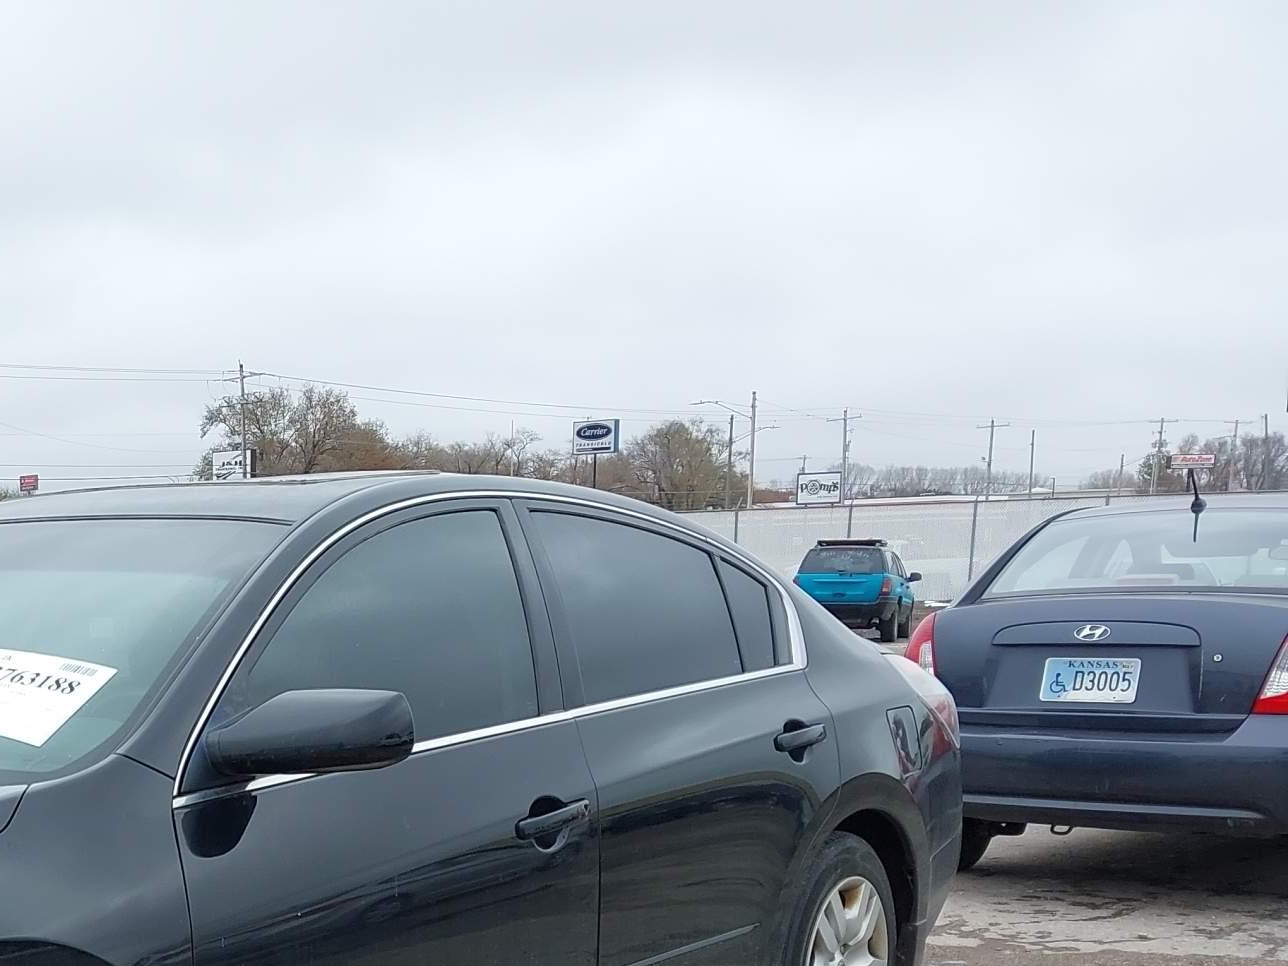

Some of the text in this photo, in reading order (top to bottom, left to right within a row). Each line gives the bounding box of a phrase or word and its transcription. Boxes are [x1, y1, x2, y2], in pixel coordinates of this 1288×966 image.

[581, 427, 608, 437] Carrier
[1068, 660, 1119, 669] KANSAS
[1072, 671, 1133, 692] D3005
